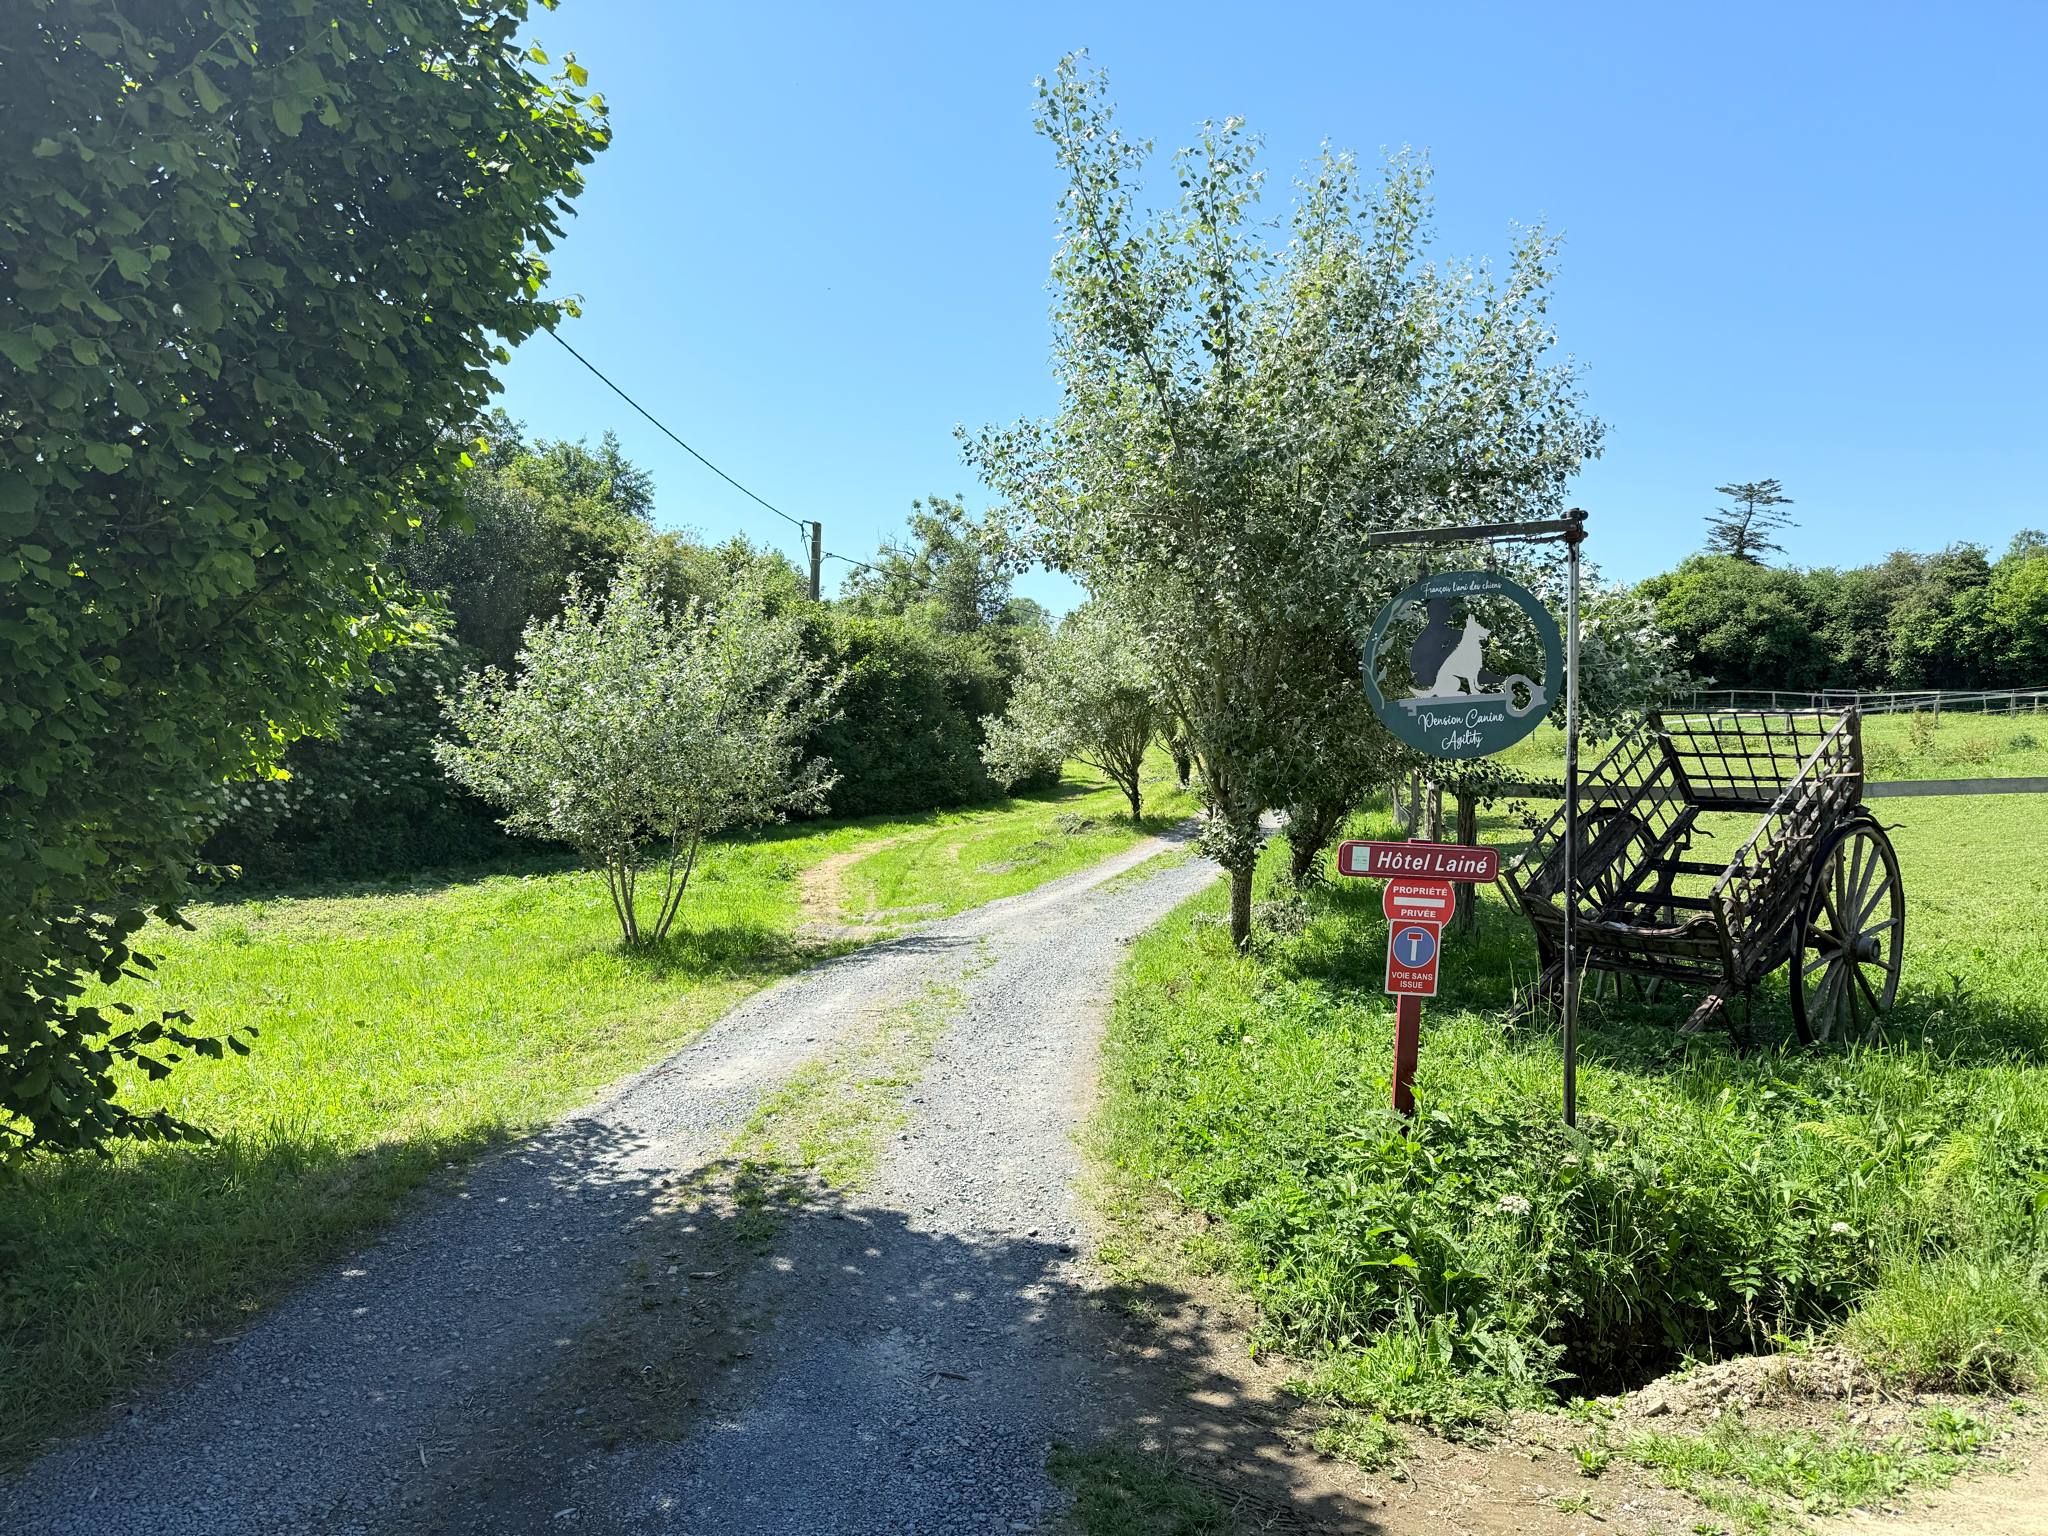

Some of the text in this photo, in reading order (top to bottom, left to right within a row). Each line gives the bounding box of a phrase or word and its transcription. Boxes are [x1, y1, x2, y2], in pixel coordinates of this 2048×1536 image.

[1420, 582, 1451, 597] François
[1469, 581, 1481, 591] des
[1482, 581, 1502, 589] chiens
[1418, 709, 1504, 732] Pension Canine
[1442, 730, 1483, 750] Agility
[1377, 851, 1430, 870] Hôtel
[1435, 854, 1488, 873] Lainé
[1393, 886, 1447, 896] PROPRIÉTÉ
[1401, 908, 1436, 918] PRIVÉE
[1411, 972, 1433, 980] SANS
